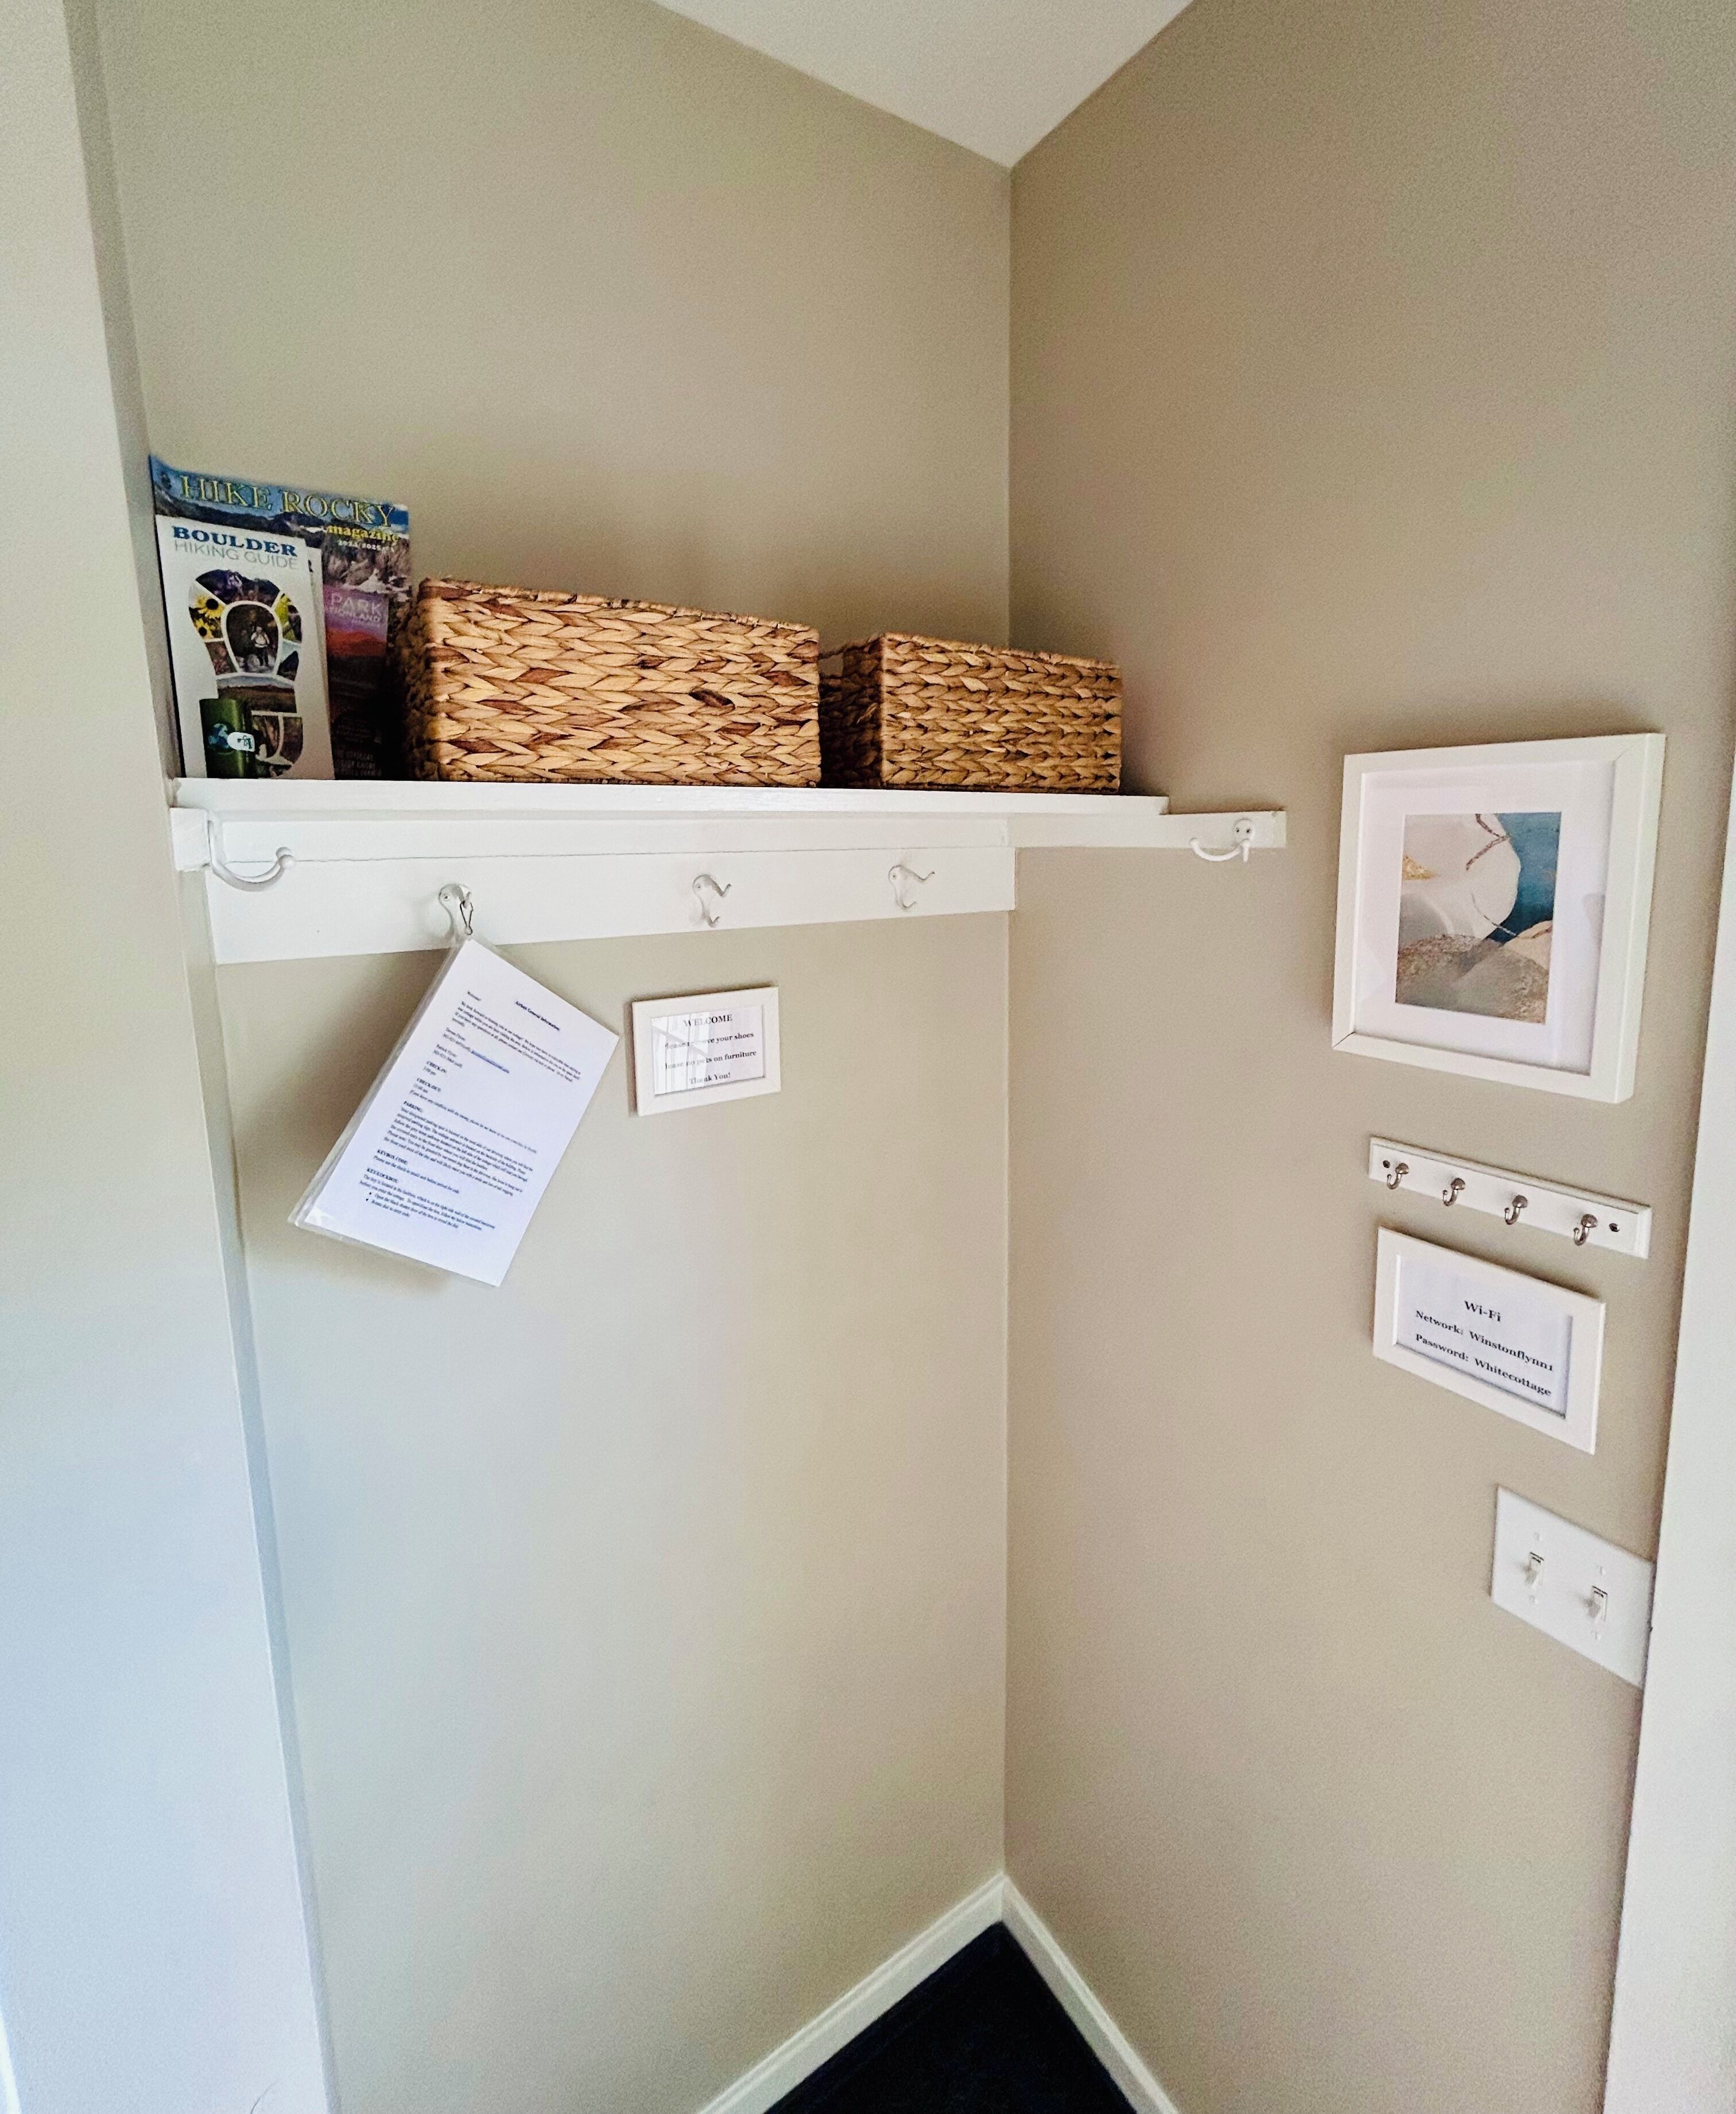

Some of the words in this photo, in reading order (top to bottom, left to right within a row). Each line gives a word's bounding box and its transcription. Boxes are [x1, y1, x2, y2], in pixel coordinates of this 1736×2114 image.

[180, 475, 273, 510] HIKE
[280, 490, 394, 528] ROCKY
[172, 525, 298, 557] BOULDER
[327, 525, 399, 541] magazine
[174, 540, 239, 560] HIKING
[243, 550, 299, 570] GUIDE
[331, 592, 382, 617] PARK
[684, 1014, 733, 1027] WELCOME
[716, 1036, 733, 1044] your
[696, 1057, 712, 1066] pets
[724, 1051, 757, 1060] furniture
[690, 1075, 712, 1085] Thank
[714, 1072, 731, 1080] You!
[1464, 1300, 1501, 1322] Wi-Fi
[1416, 1310, 1463, 1335] Network:
[1469, 1330, 1553, 1372] Winstonflynn1
[1416, 1333, 1469, 1361] Password:
[1474, 1357, 1552, 1396] Whitecottage
